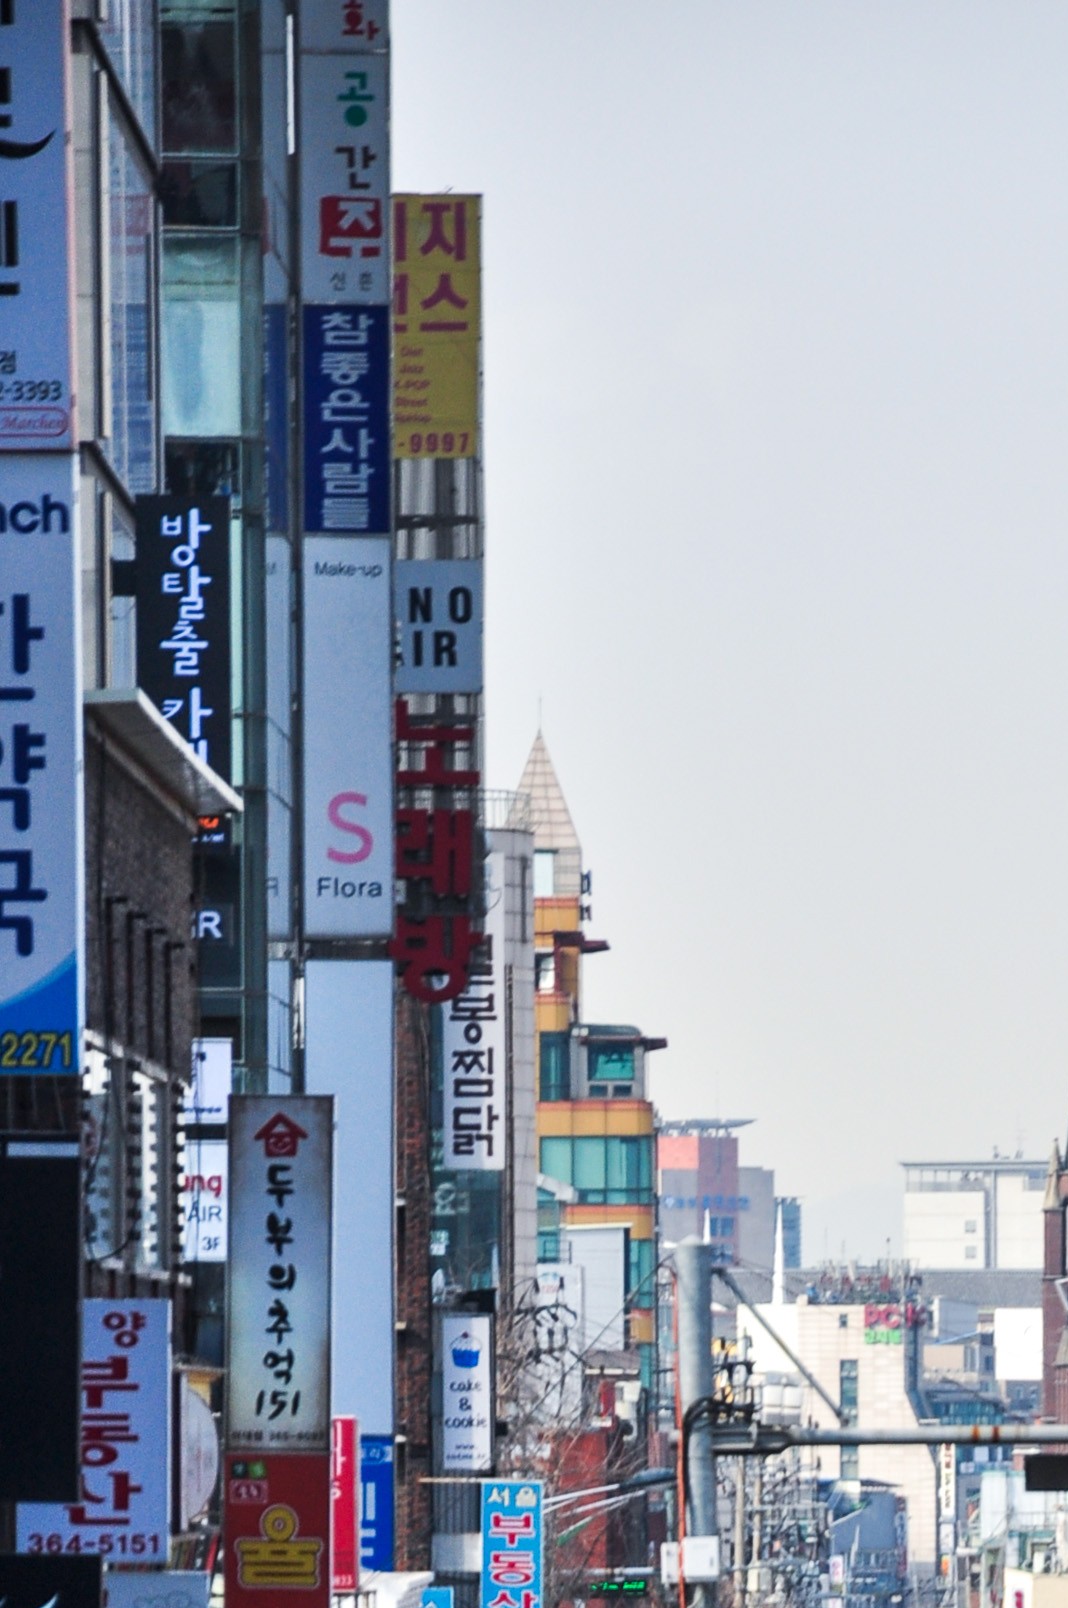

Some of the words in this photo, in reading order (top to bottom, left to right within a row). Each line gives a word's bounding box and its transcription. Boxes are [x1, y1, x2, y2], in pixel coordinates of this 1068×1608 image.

[319, 312, 376, 530] 참좋은사람들
[313, 560, 384, 578] Make-up
[159, 508, 212, 676] 방탈출
[315, 876, 384, 898] Flora
[447, 1380, 483, 1394] cake
[444, 1418, 488, 1431] cookie
[486, 1487, 538, 1508] 서울
[27, 1533, 161, 1553] 364-5151
